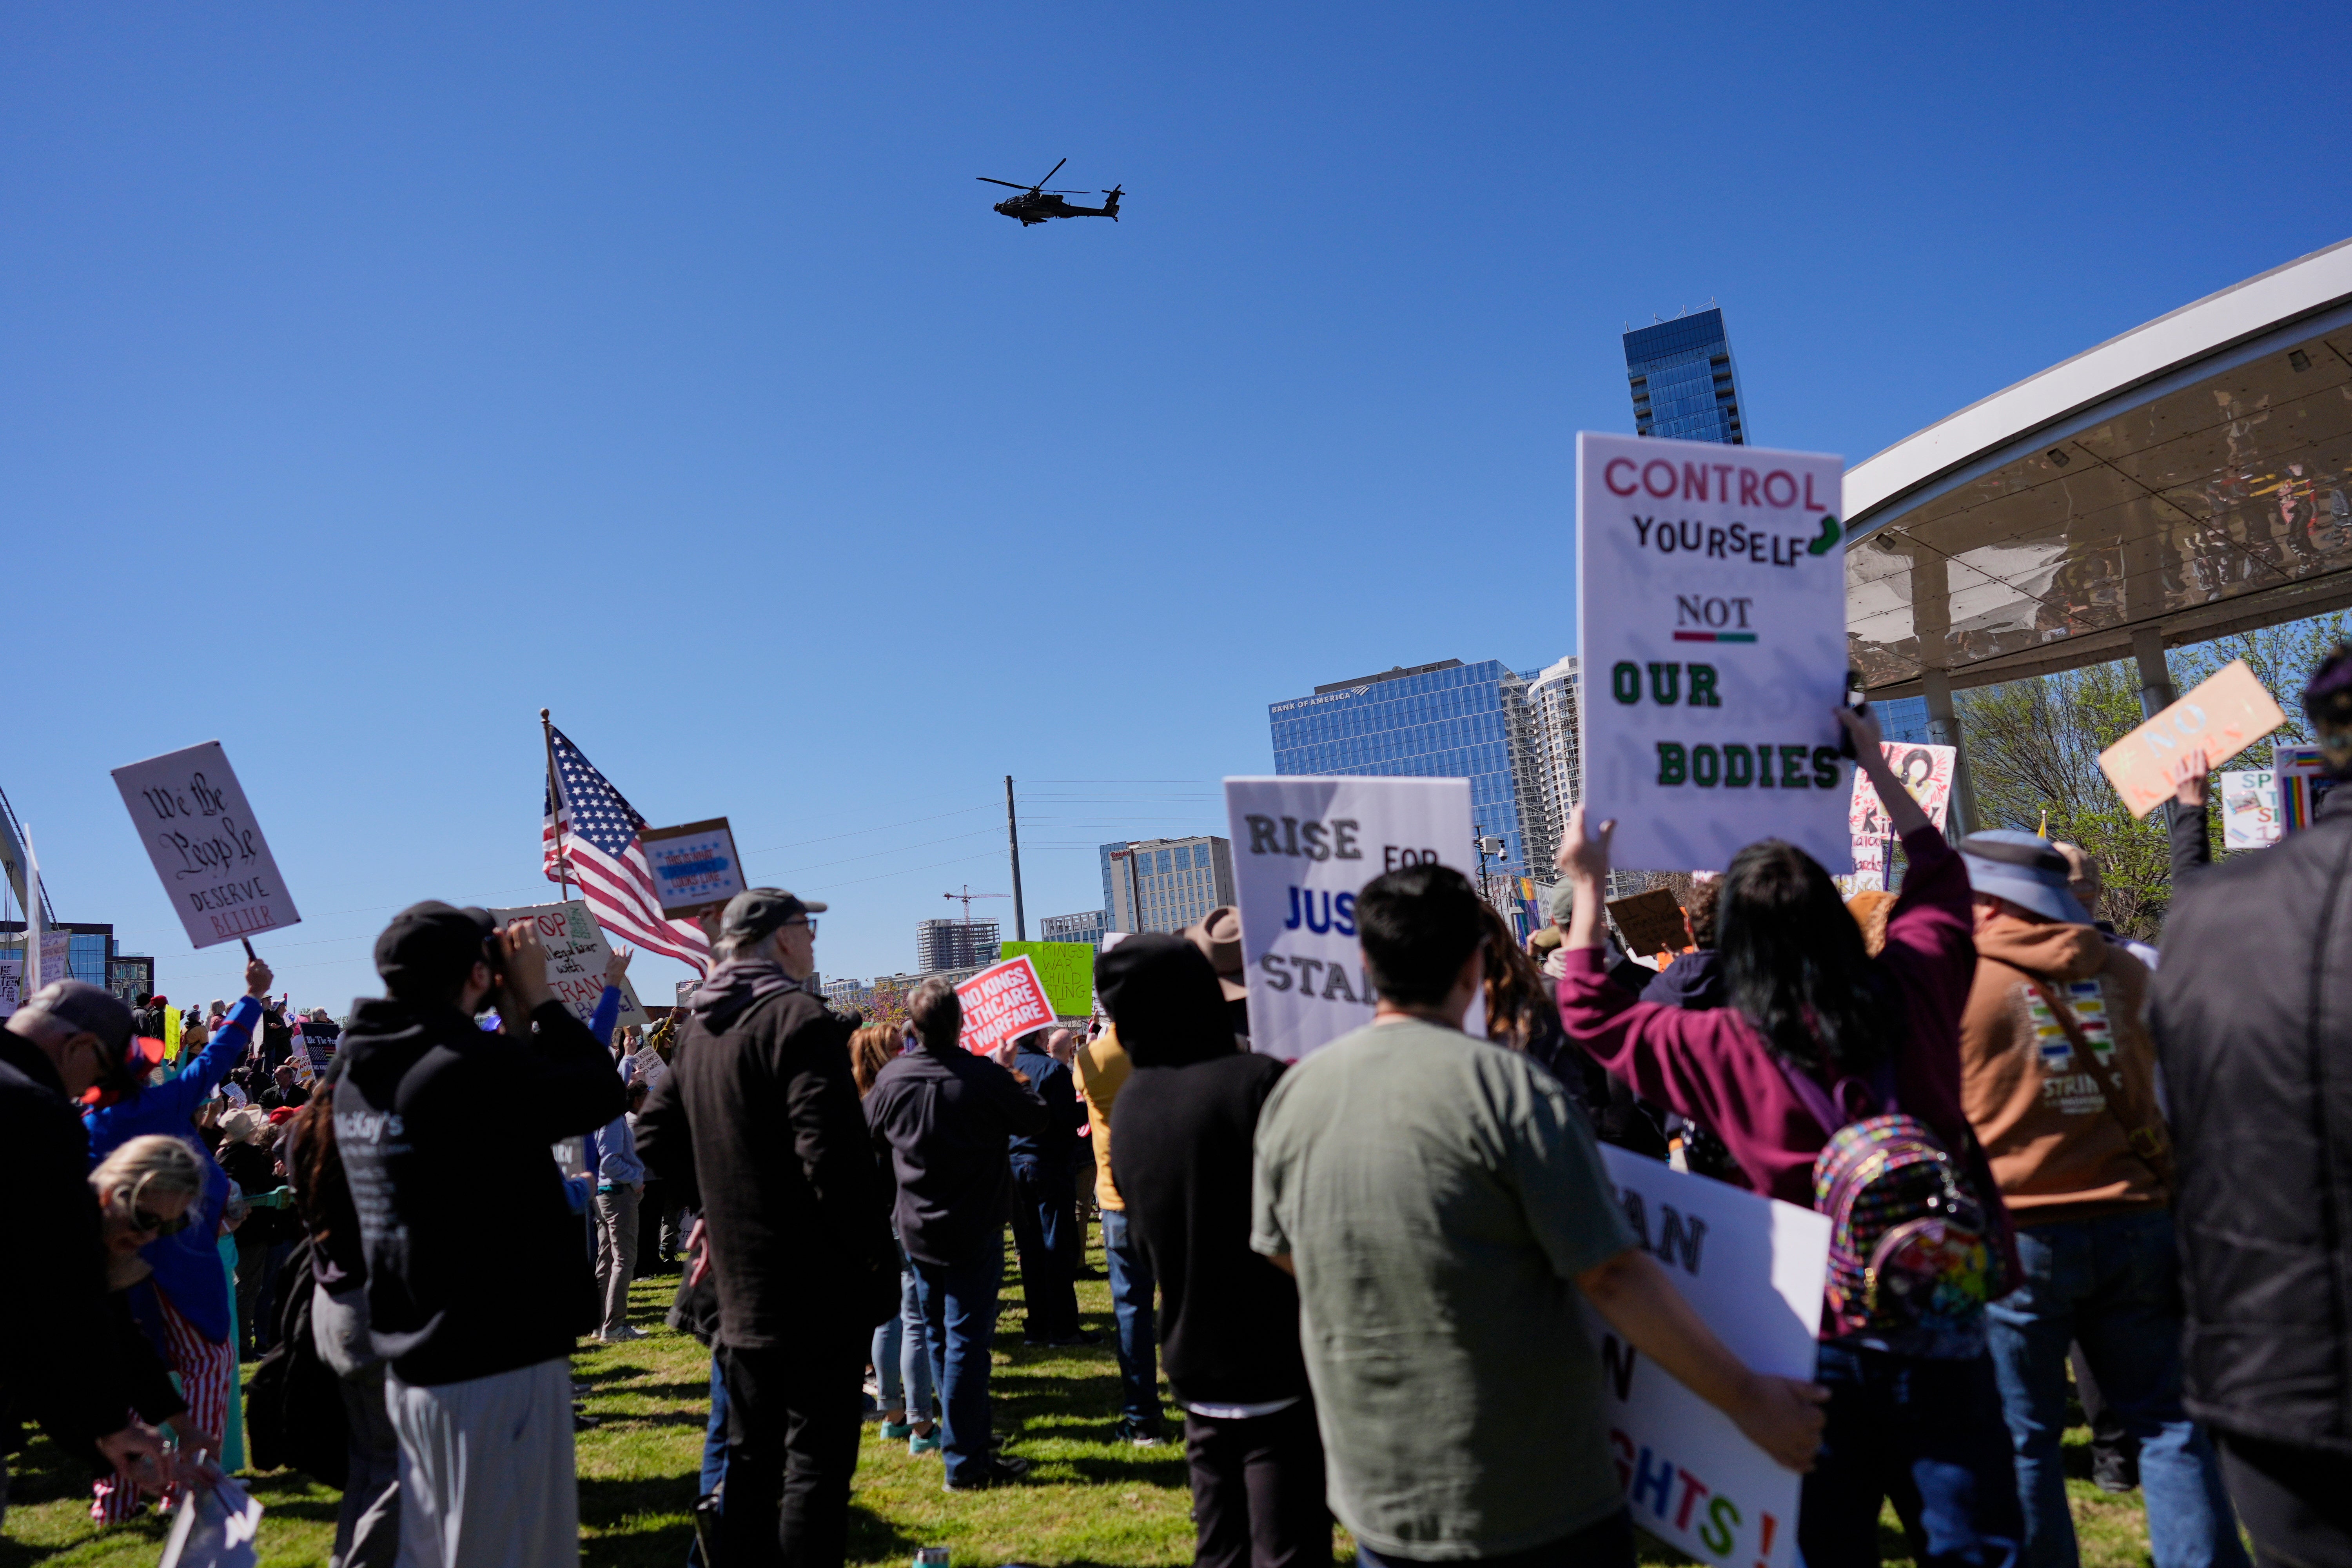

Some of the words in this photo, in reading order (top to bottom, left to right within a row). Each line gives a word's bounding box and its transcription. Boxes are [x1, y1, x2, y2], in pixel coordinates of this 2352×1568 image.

[1604, 456, 1826, 512] CONTROL
[1632, 515, 1804, 568] YOURSELF
[1675, 595, 1753, 628] NOT
[1613, 661, 1721, 707] OUR
[1272, 703, 1295, 713] BANK
[1310, 692, 1350, 706] AMERICA
[1656, 742, 1842, 788] BODIES
[142, 786, 192, 819] We
[158, 817, 257, 880] People
[1245, 814, 1362, 862] RISE
[1110, 850, 1131, 858] DRURY
[190, 877, 270, 912] DESERVE
[211, 906, 276, 937] BETTER
[576, 943, 598, 955] war
[1012, 945, 1034, 957] NO
[1042, 944, 1085, 958] KINGS
[555, 959, 585, 974] with
[1040, 972, 1082, 985] CHILD
[1042, 959, 1072, 971] WAR
[1261, 954, 1378, 1005] STA
[958, 987, 983, 1012] NO
[981, 967, 1028, 999] KINGS
[1046, 984, 1086, 998] STING
[971, 1001, 1044, 1048] WARFARE
[305, 1036, 316, 1044] We
[315, 1036, 327, 1045] The
[639, 1049, 654, 1060] KINGS
[644, 1054, 658, 1067] CAMPS
[649, 1060, 662, 1071] WARS
